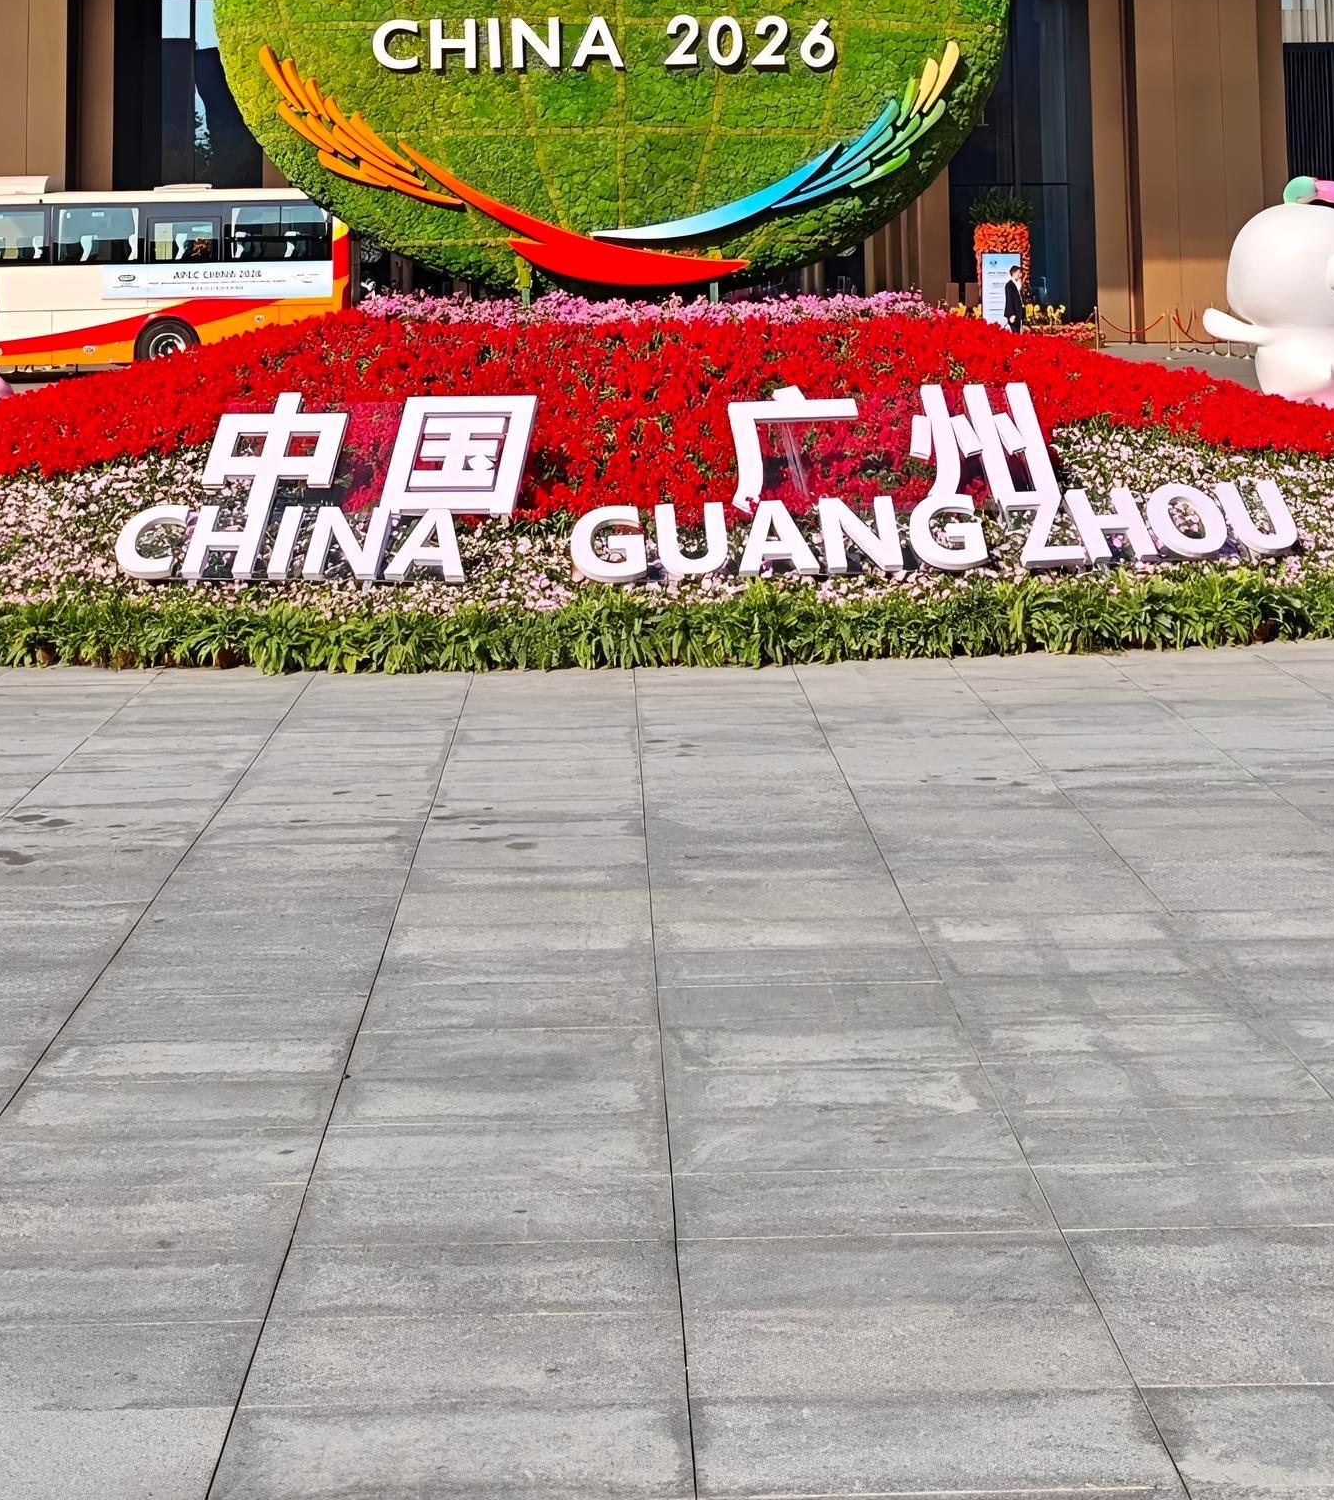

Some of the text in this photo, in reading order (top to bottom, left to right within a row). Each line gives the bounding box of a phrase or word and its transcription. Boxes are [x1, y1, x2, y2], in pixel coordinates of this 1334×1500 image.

[371, 14, 836, 71] CHINA 2026
[202, 382, 1064, 518] 中国 广州
[115, 503, 466, 583] CHINA
